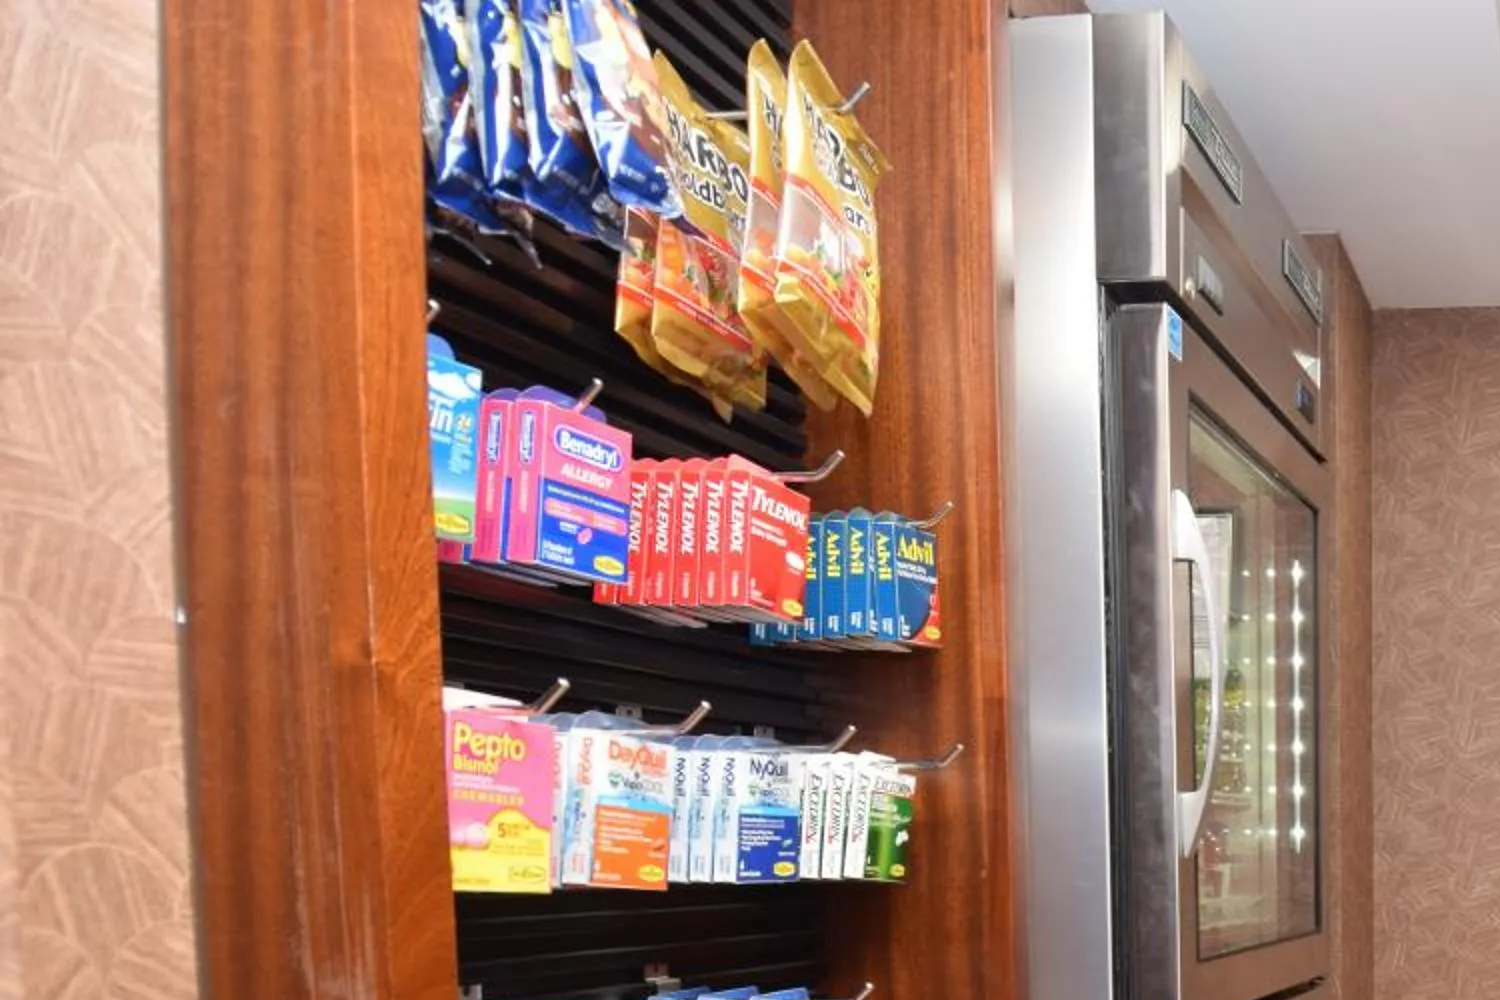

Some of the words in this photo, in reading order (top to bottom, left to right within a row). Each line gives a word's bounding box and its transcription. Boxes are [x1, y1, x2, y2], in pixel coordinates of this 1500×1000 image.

[560, 429, 617, 469] Benadryl
[561, 463, 613, 488] ALLERGY
[655, 480, 674, 555] TYLENOL
[681, 480, 699, 555] TYLENOL
[706, 479, 725, 554] TYLENOL
[731, 479, 750, 555] TYLENOL
[751, 486, 809, 532] TYLENOL
[826, 529, 842, 578] Advil
[850, 526, 866, 576] Advil
[875, 531, 893, 581] Advil
[897, 533, 935, 567] Advil
[453, 721, 527, 766] Pepto
[609, 739, 668, 771] DayQuil
[749, 757, 789, 780] NyQuil
